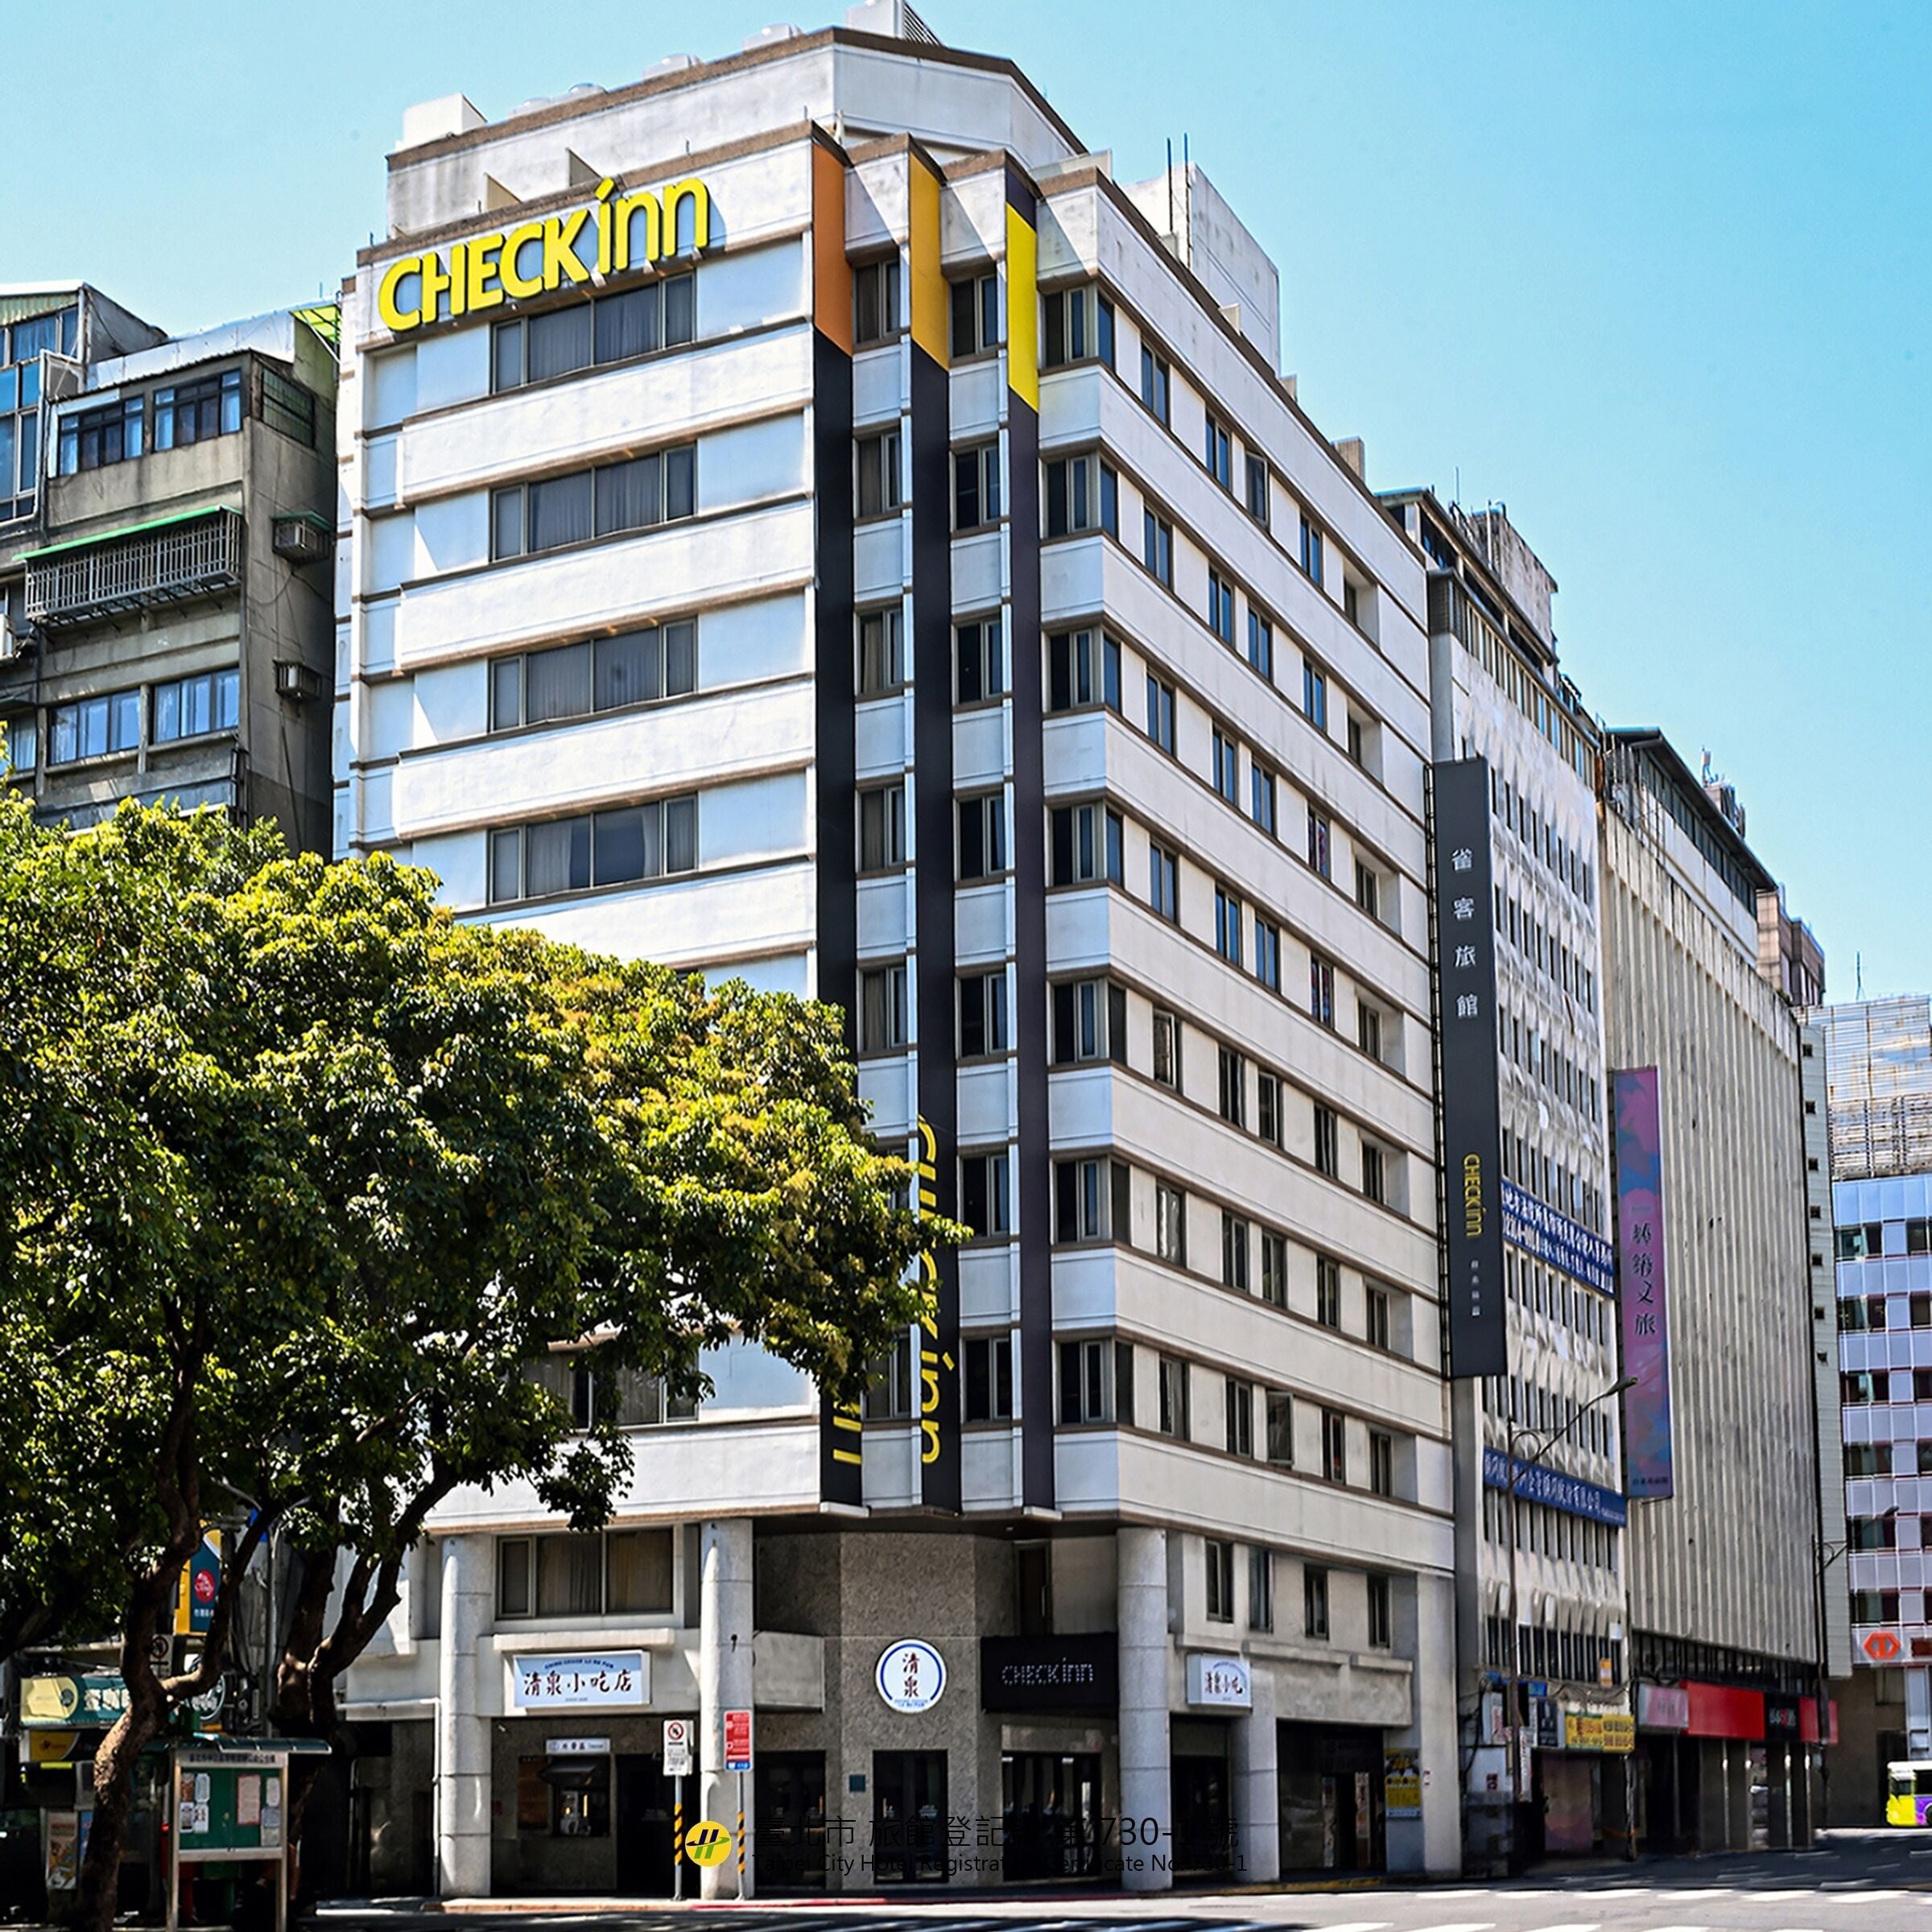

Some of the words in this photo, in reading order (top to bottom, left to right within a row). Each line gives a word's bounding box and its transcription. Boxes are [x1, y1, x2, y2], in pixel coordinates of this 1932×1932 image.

[378, 177, 710, 332] CHECKinn
[1461, 1152, 1488, 1238] CHECKinn
[524, 1670, 633, 1696] 清泉小吃店
[901, 1652, 920, 1698] 清泉
[1001, 1657, 1094, 1686] CHECKinn
